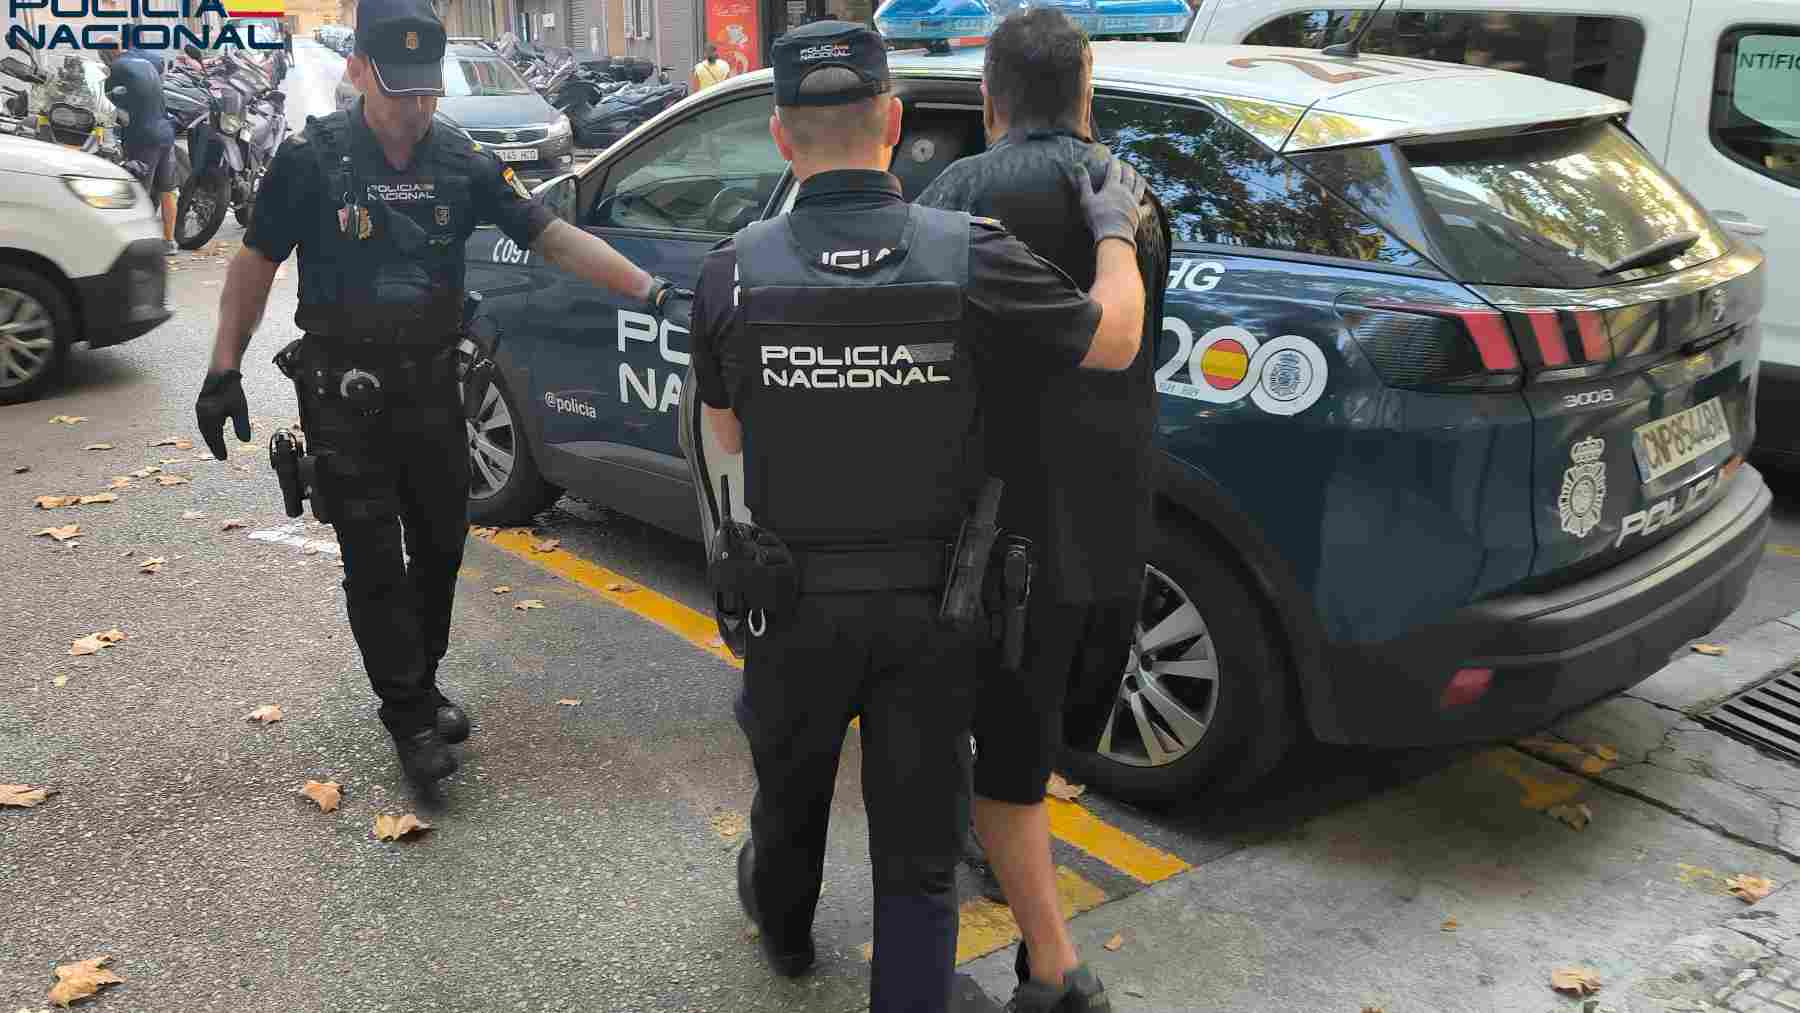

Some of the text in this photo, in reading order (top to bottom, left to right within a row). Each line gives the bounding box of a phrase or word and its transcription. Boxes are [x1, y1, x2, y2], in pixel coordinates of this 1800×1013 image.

[367, 191, 437, 201] NACIONAL
[761, 344, 914, 366] POLICIA
[763, 366, 951, 389] NACIONAL
[544, 391, 597, 418] @policia
[1563, 389, 1615, 408] 3008
